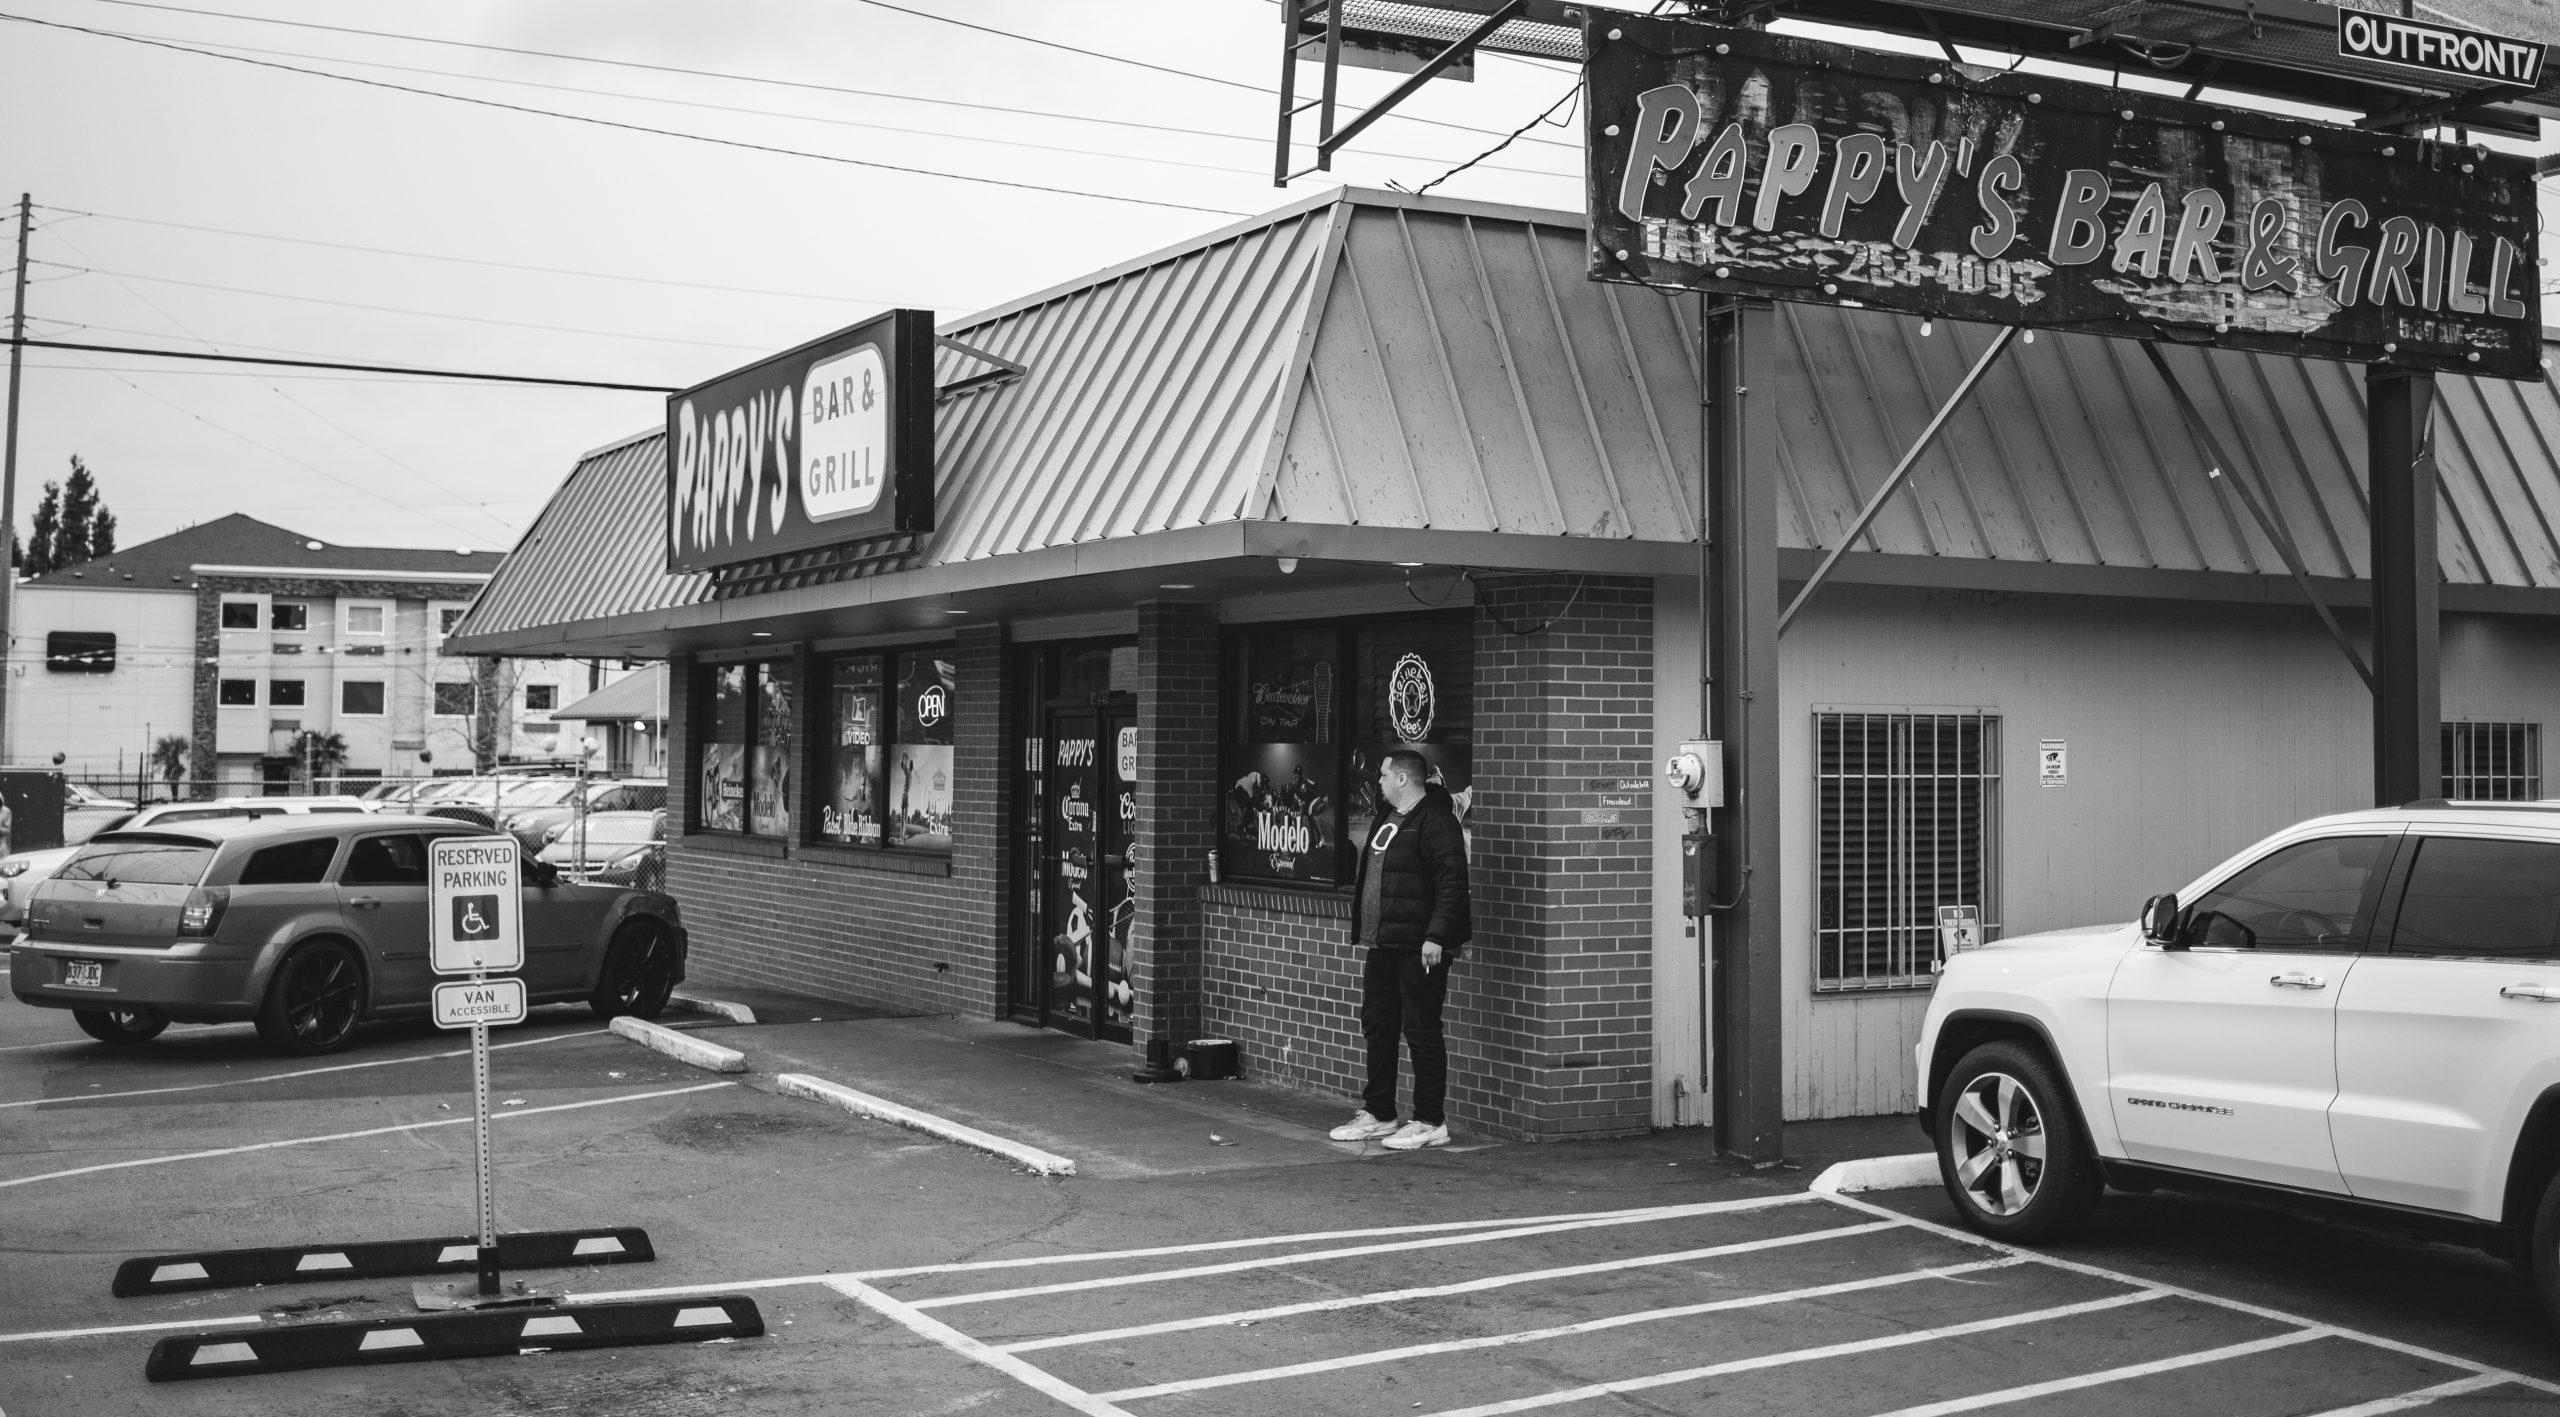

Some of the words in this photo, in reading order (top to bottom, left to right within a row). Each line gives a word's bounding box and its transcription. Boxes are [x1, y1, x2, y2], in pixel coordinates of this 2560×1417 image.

[1619, 84, 2021, 259] PAPPY'S
[2047, 169, 2226, 283] BAR
[2242, 199, 2298, 293] &
[2316, 198, 2526, 319] GRILL
[813, 376, 855, 424] BAR
[862, 367, 876, 412] &
[673, 384, 794, 559] PAPPY'S
[809, 446, 875, 497] GRILL
[1253, 682, 1313, 705] Budweiser
[1394, 667, 1429, 706] Heineken
[918, 694, 945, 718] OPEN
[1260, 716, 1276, 726] ON
[1280, 718, 1298, 728] TAP
[847, 730, 871, 745] VIDEO
[1057, 738, 1095, 767] PAPPY'S
[722, 783, 744, 798] Heineke
[1062, 795, 1089, 819] Corona
[822, 805, 842, 836] Pabst
[843, 808, 858, 836] Blue
[858, 814, 881, 838] Ribbon
[1069, 819, 1083, 832] Extra
[1258, 812, 1310, 854] Modelo
[437, 847, 512, 866] RESERVED
[443, 870, 508, 888] PARKING
[464, 990, 495, 1004] VAN
[449, 1003, 511, 1017] ACCESSIBLE
